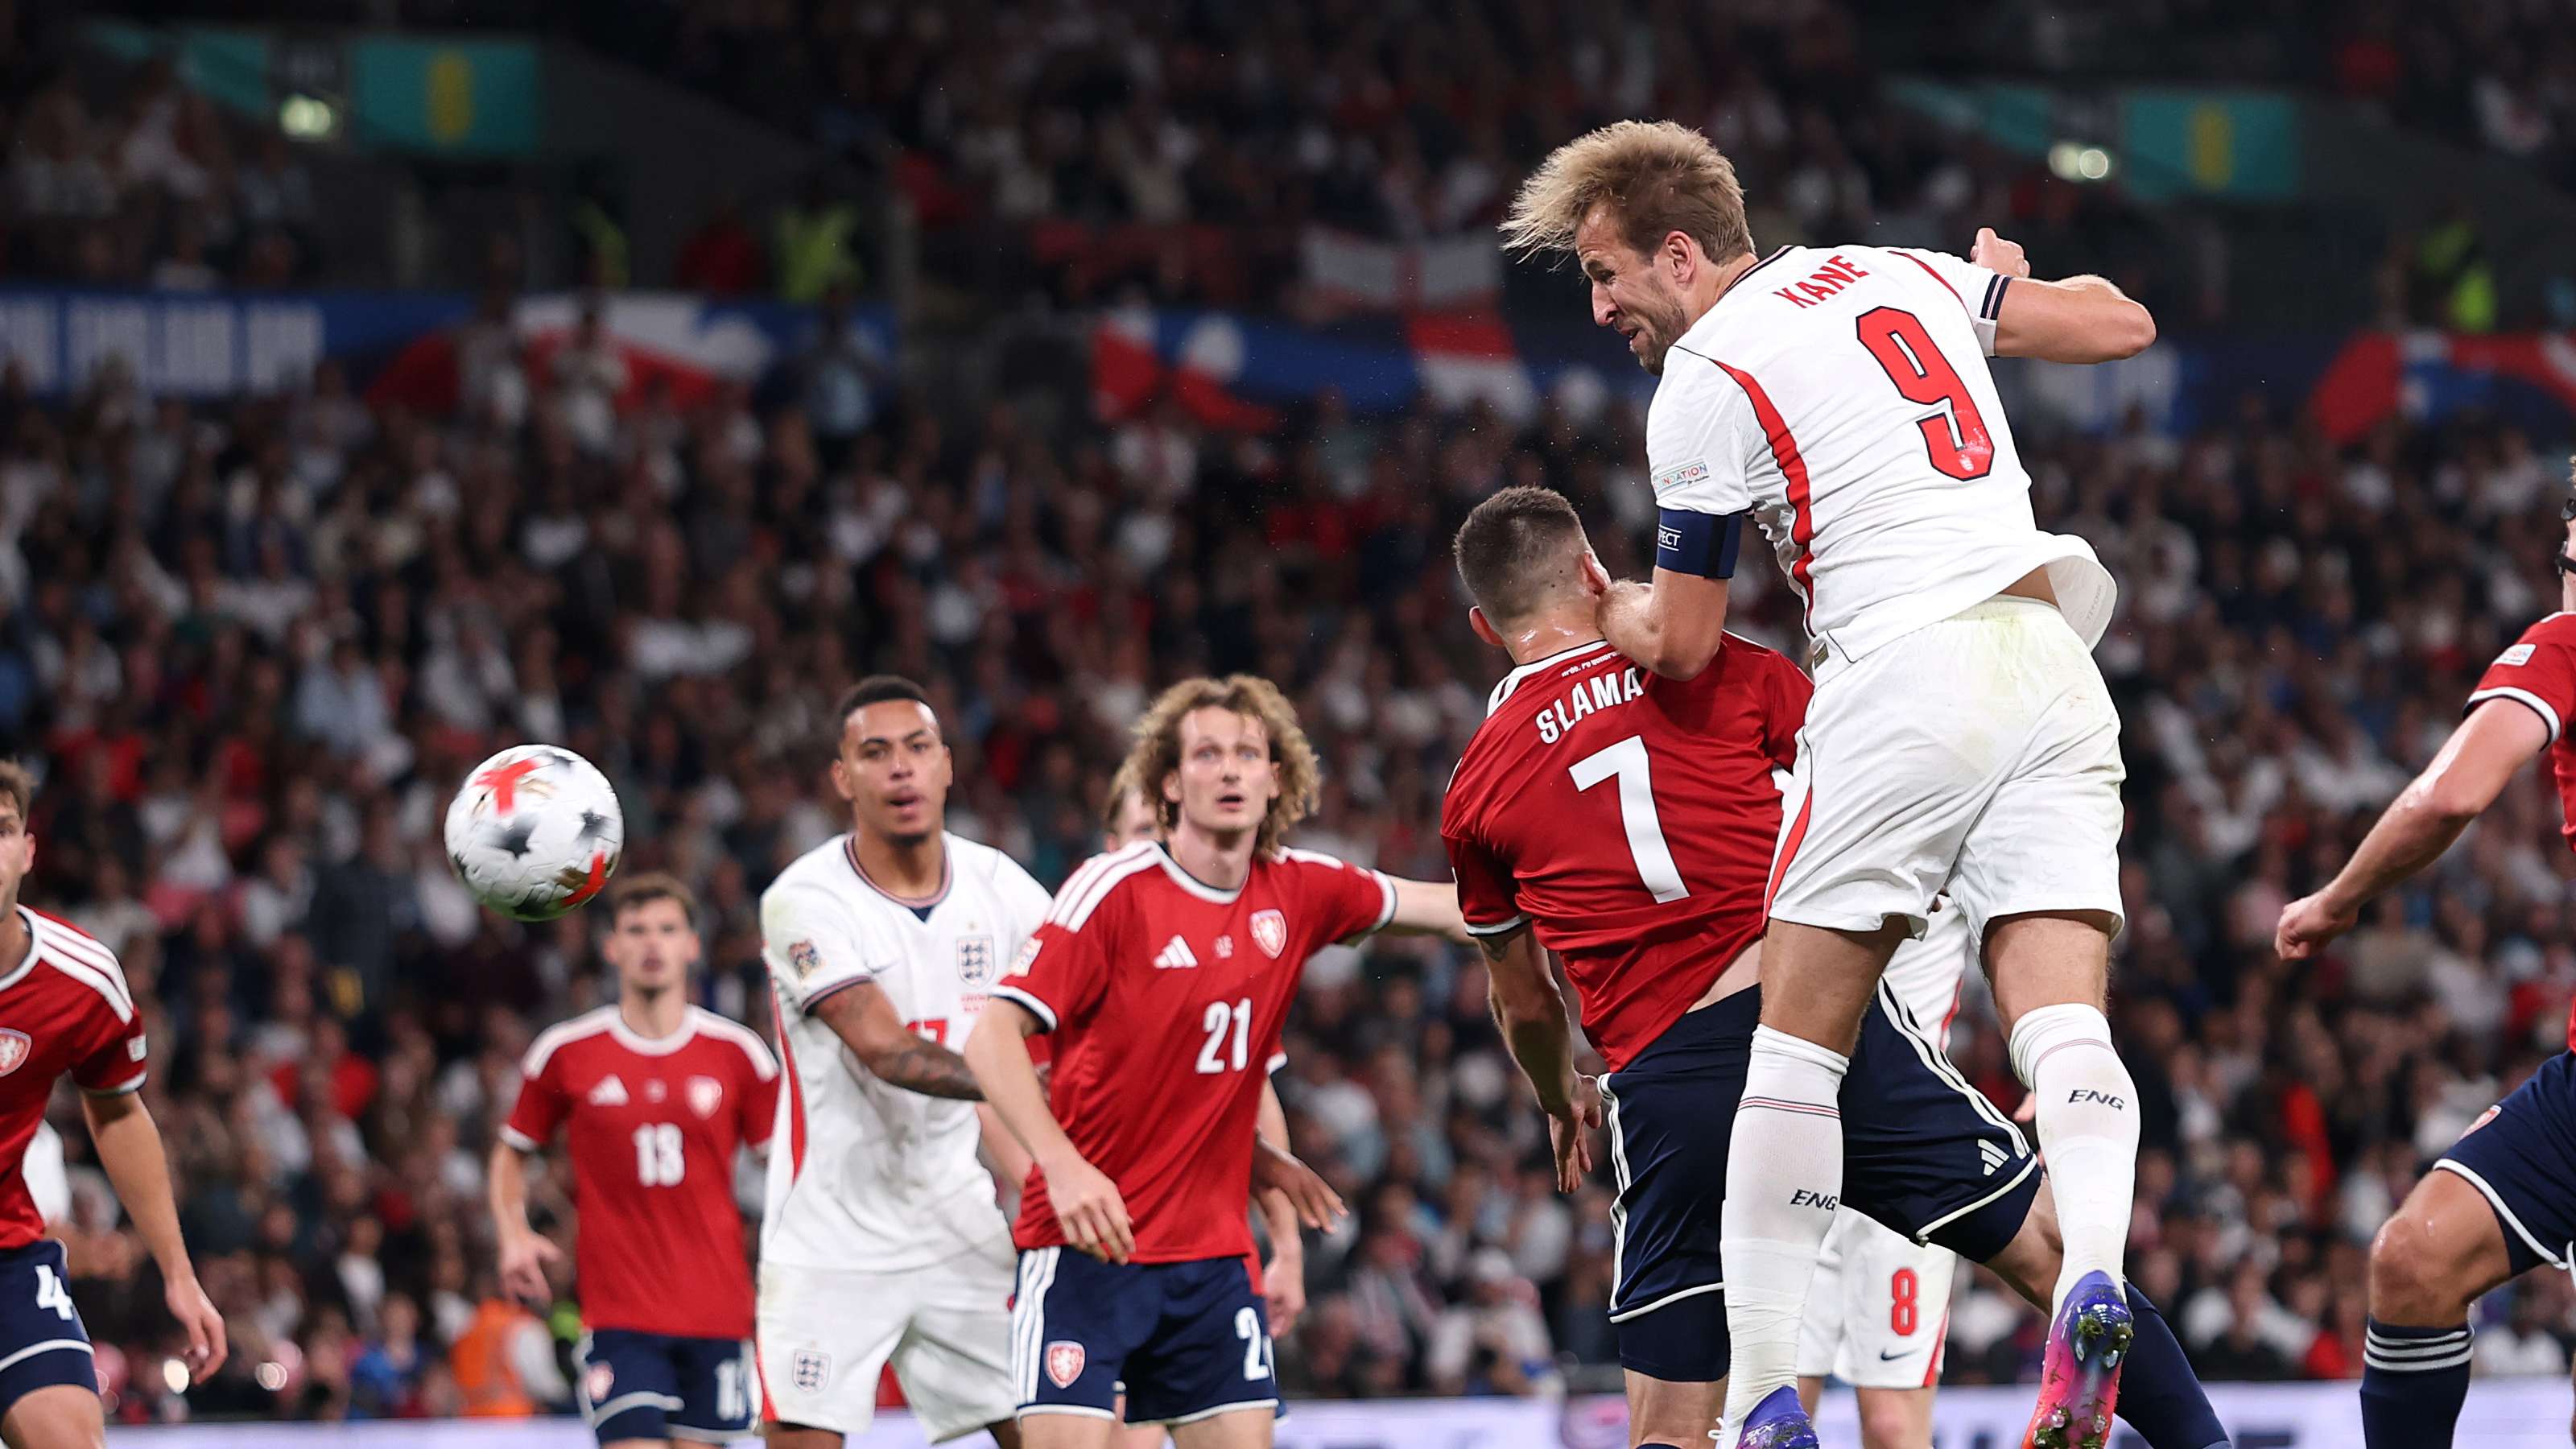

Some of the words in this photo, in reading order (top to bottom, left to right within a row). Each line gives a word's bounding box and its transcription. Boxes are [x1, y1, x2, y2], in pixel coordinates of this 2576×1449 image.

[1772, 254, 1869, 308] KANE
[1856, 305, 1995, 481] 9
[1658, 528, 1681, 547] PECT
[1568, 734, 1690, 904] 7
[905, 1018, 947, 1045] 7
[1195, 997, 1252, 1075] 21
[2067, 1088, 2125, 1112] ENG
[1790, 1188, 1839, 1212] ENG
[35, 1264, 74, 1321] 4
[1891, 1267, 1918, 1337] 8
